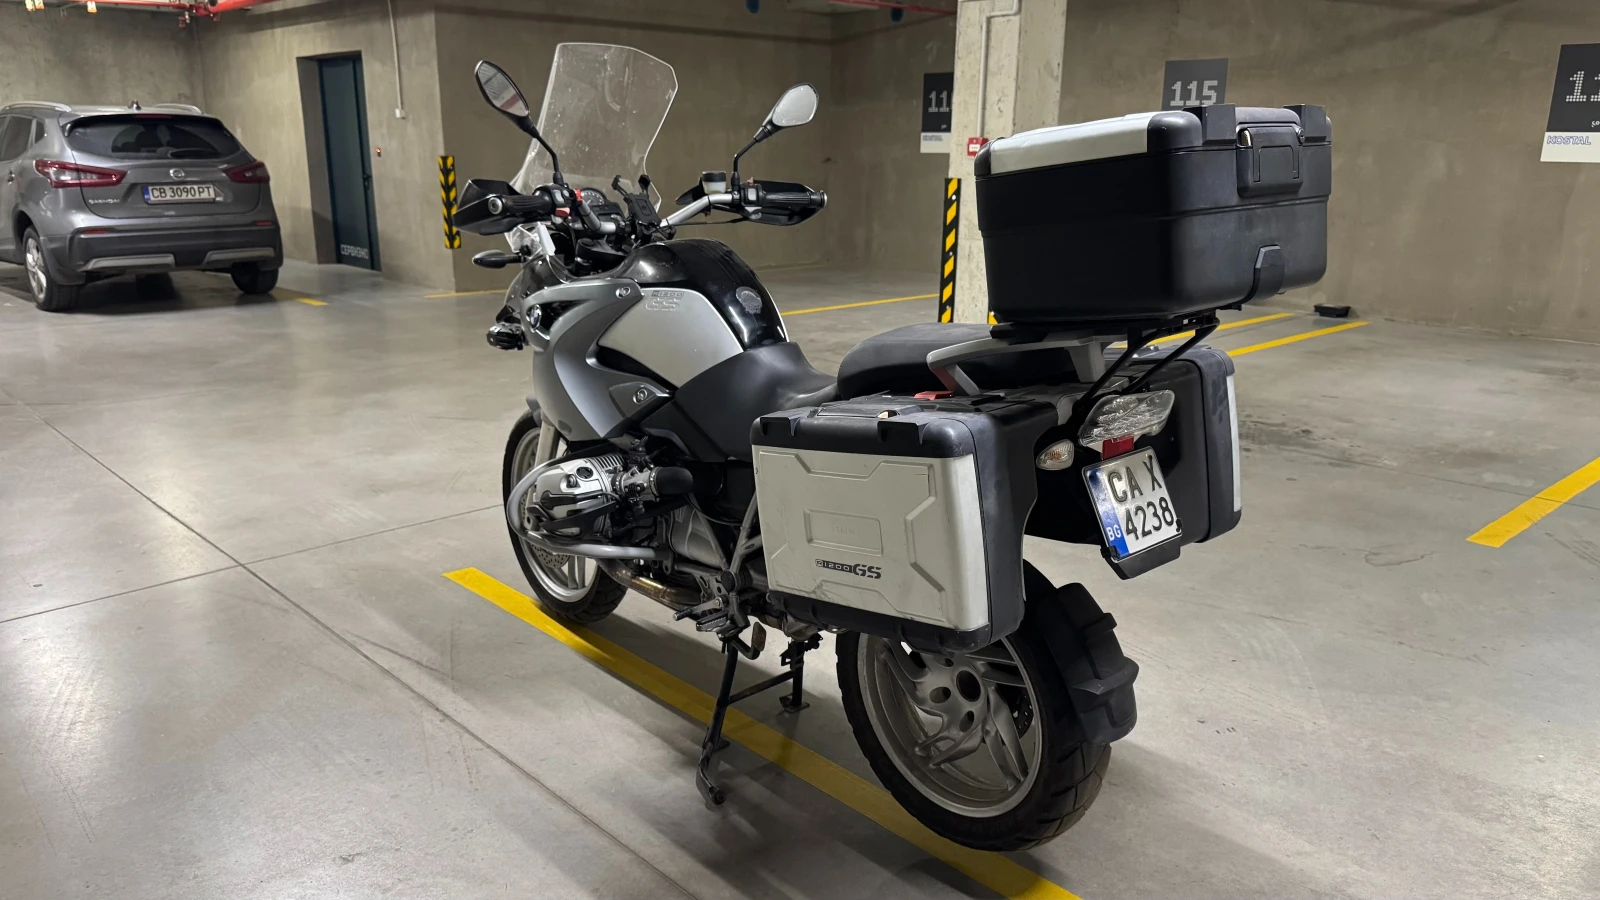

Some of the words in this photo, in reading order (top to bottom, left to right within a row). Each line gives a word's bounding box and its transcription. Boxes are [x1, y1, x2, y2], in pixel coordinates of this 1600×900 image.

[928, 90, 952, 112] 11
[1170, 81, 1218, 106] 115
[1547, 136, 1591, 145] KOSTAL
[151, 186, 167, 198] CB
[170, 186, 196, 198] 3090
[199, 185, 212, 197] PT
[1108, 466, 1144, 503] CA
[1142, 455, 1163, 492] X
[1125, 496, 1175, 541] 4238
[1106, 524, 1122, 541] BG
